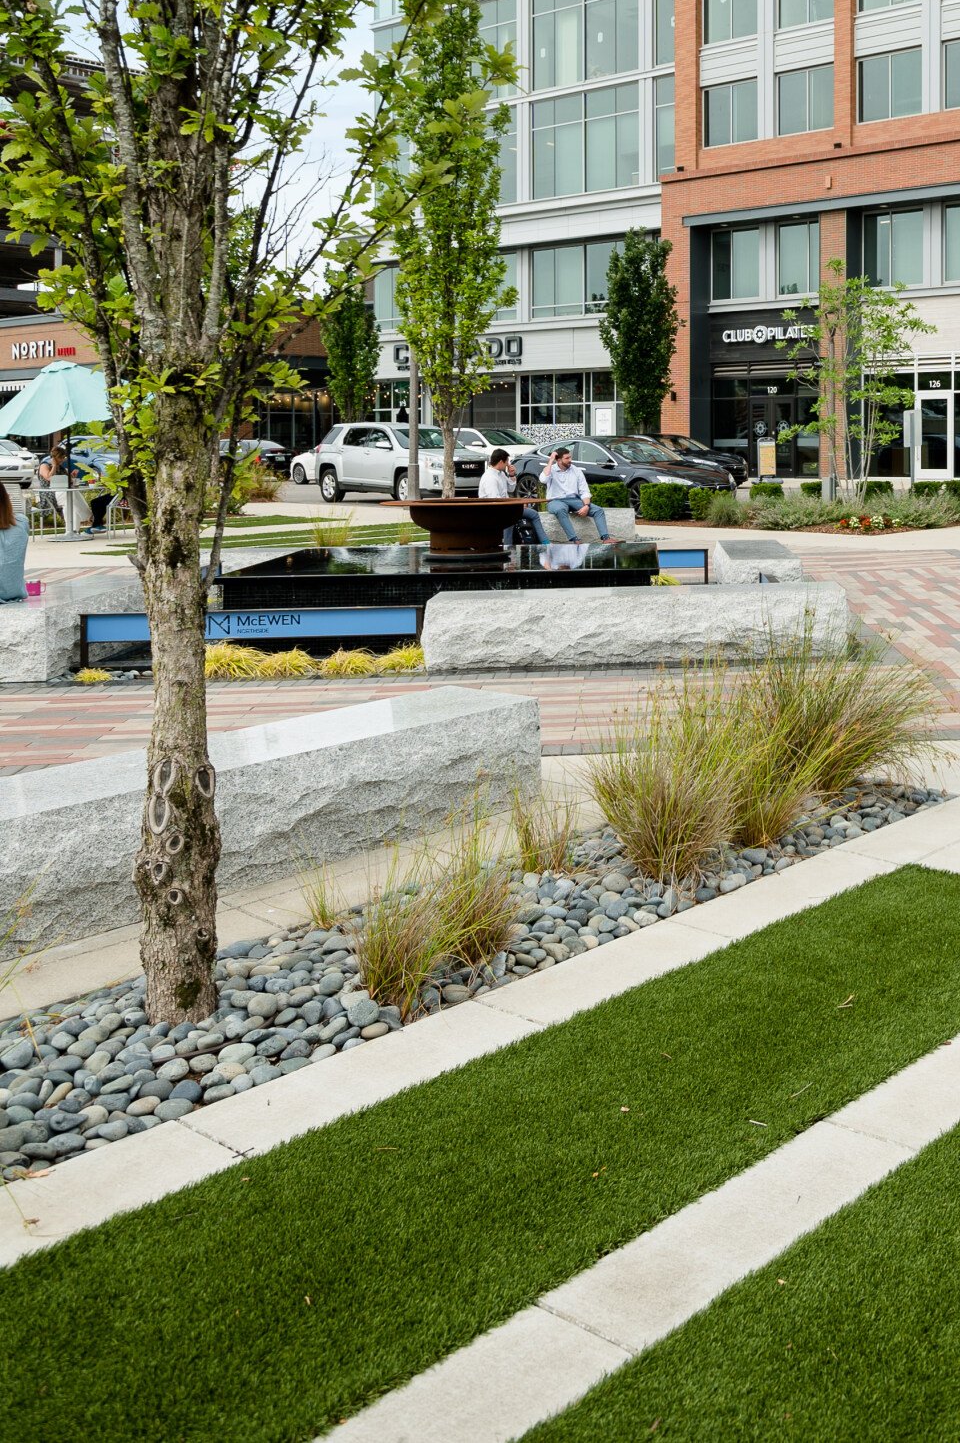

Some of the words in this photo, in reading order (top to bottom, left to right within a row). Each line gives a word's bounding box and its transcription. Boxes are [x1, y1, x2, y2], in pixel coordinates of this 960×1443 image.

[722, 329, 754, 343] CLUB
[12, 339, 55, 360] NORTH
[929, 379, 941, 388] 126
[767, 386, 777, 394] 120
[237, 614, 301, 626] McEWEN
